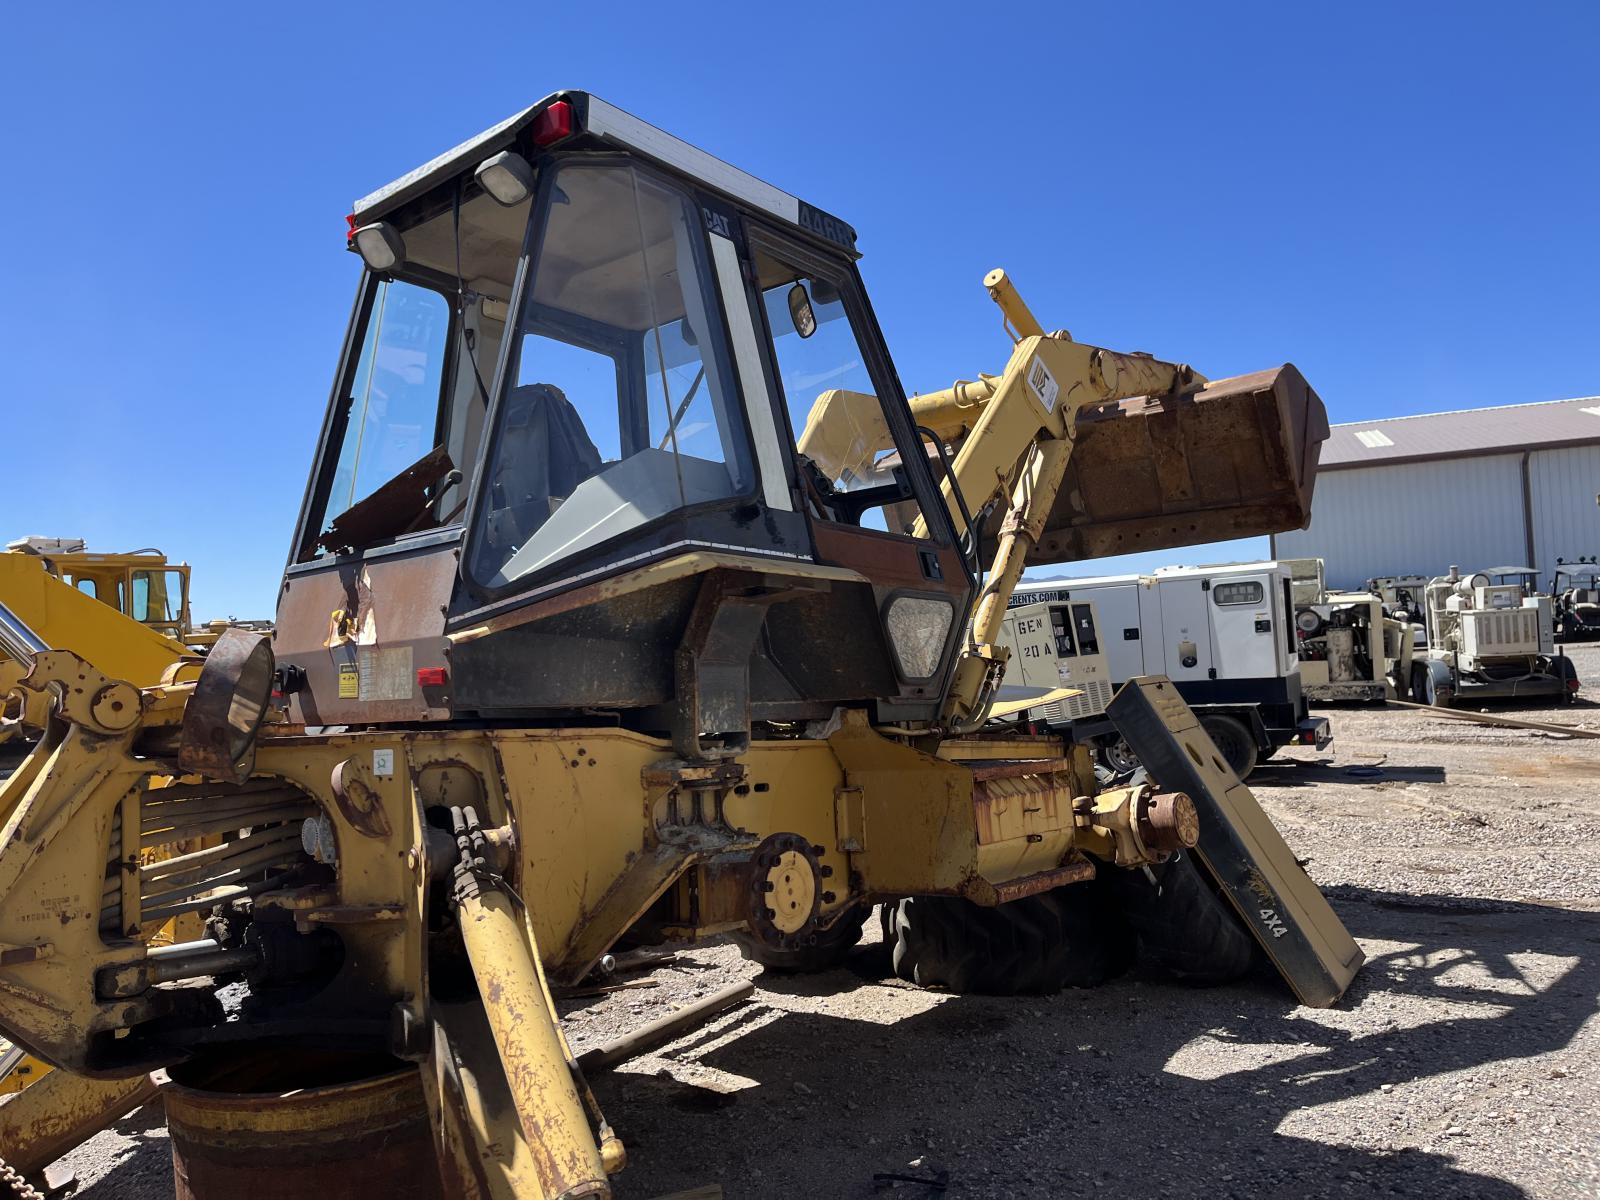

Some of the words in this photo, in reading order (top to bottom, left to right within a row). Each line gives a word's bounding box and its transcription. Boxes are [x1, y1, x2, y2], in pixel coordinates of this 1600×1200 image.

[702, 208, 730, 237] CAT
[1018, 618, 1042, 635] GEN
[1260, 909, 1288, 938] 4X4
